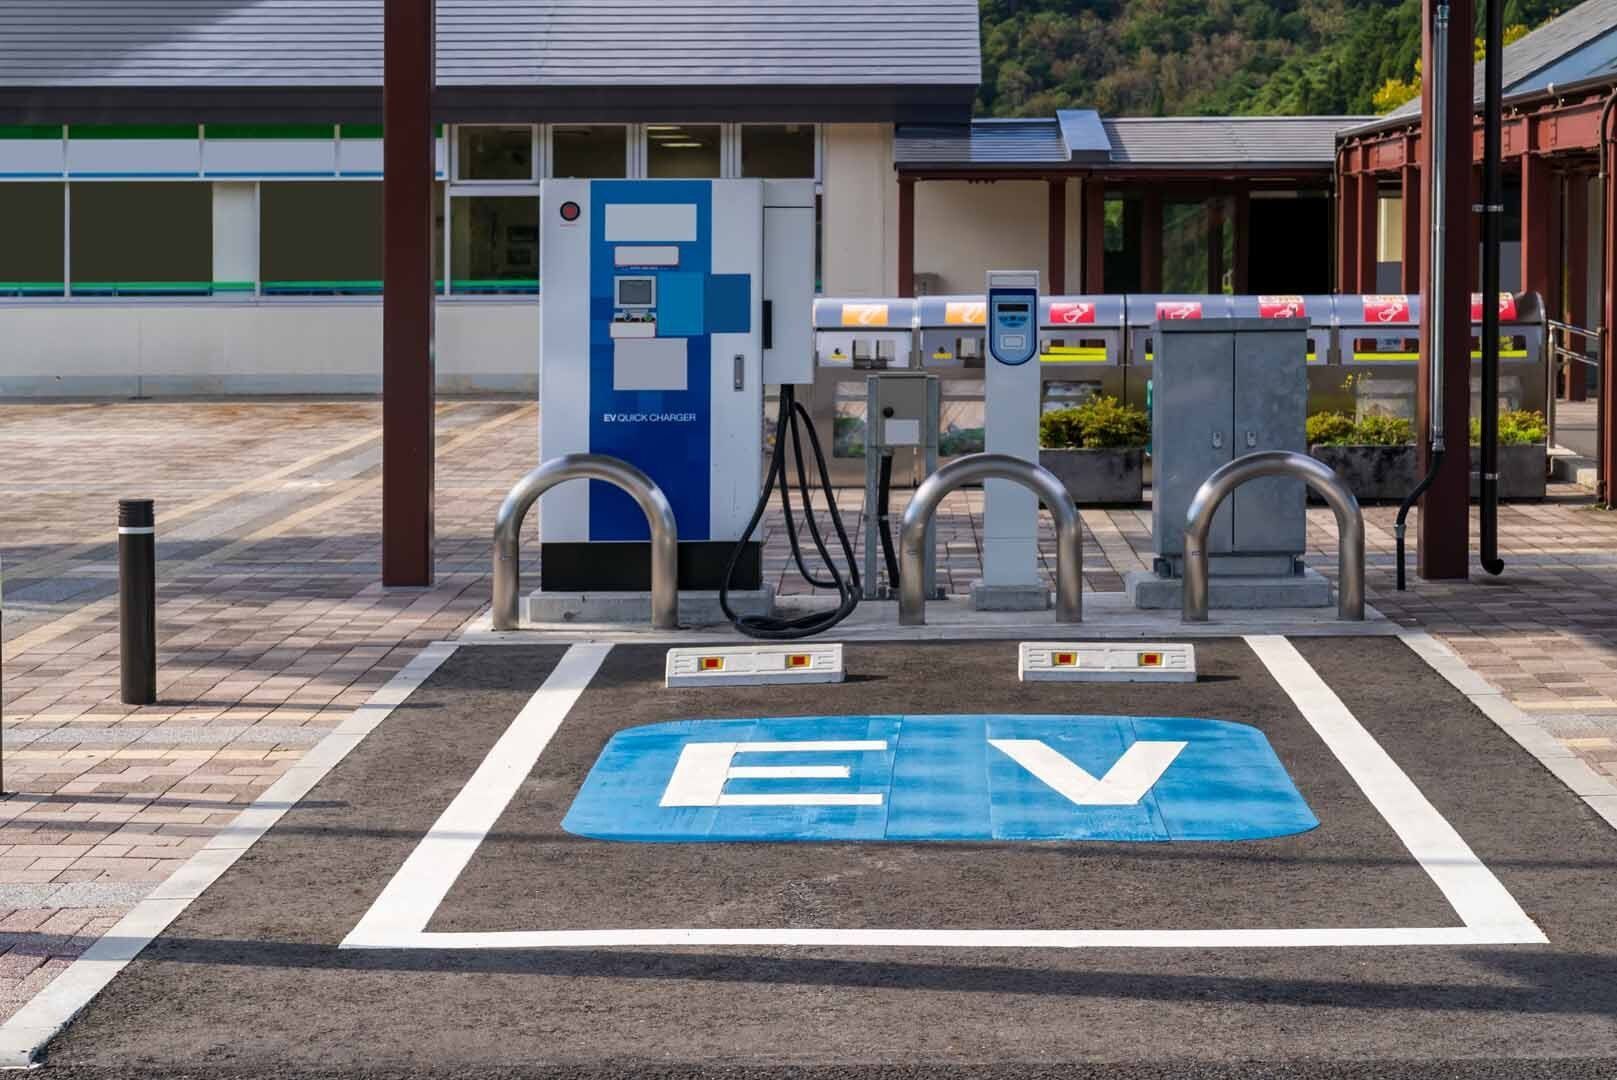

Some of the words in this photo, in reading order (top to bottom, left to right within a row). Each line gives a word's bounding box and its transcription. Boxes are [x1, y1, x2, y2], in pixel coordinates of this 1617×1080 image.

[603, 413, 617, 422] EV
[617, 413, 648, 422] QUICK
[649, 413, 697, 422] CHARGER
[659, 739, 1188, 807] EV
